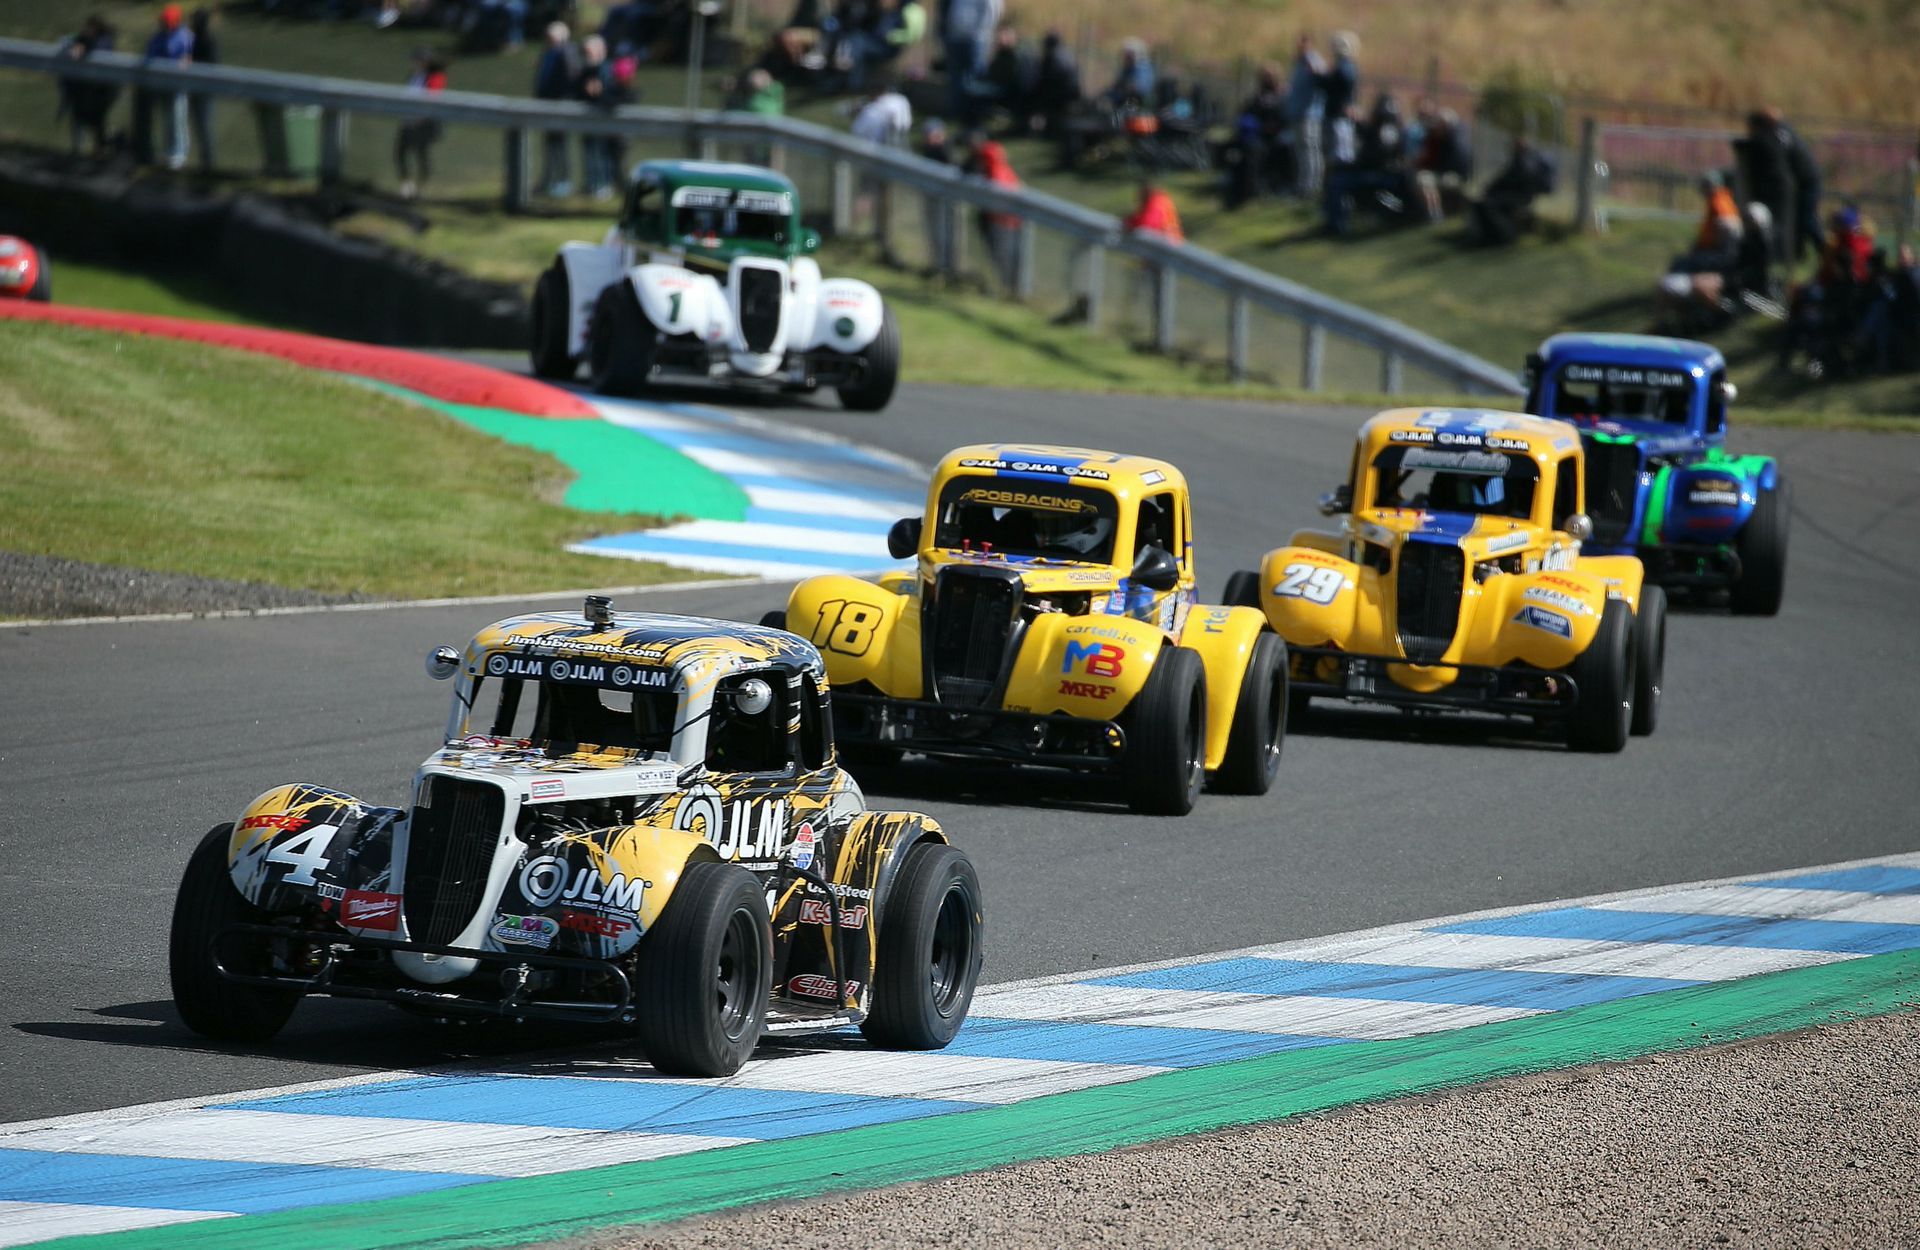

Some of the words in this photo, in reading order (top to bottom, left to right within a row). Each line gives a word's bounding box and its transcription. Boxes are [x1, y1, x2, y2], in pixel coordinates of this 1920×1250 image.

[668, 292, 683, 323] 1
[977, 460, 1007, 468] JLM
[1029, 464, 1058, 472] JLM
[1078, 468, 1109, 479] JLM
[1272, 563, 1345, 605] 29
[811, 599, 883, 657] 18
[1066, 624, 1136, 645] cartell.ie
[505, 634, 662, 658] jlmlubricants.com
[1062, 639, 1125, 678] MB
[508, 659, 543, 675] JLM
[570, 664, 604, 681] JLM
[632, 670, 667, 687] JLM
[1059, 680, 1116, 700] MRF
[237, 815, 310, 832] MRF
[720, 799, 785, 860] JLM
[265, 823, 341, 887] 4
[318, 882, 346, 900] TOW
[563, 867, 645, 911] JLM
[559, 909, 632, 939] MRF
